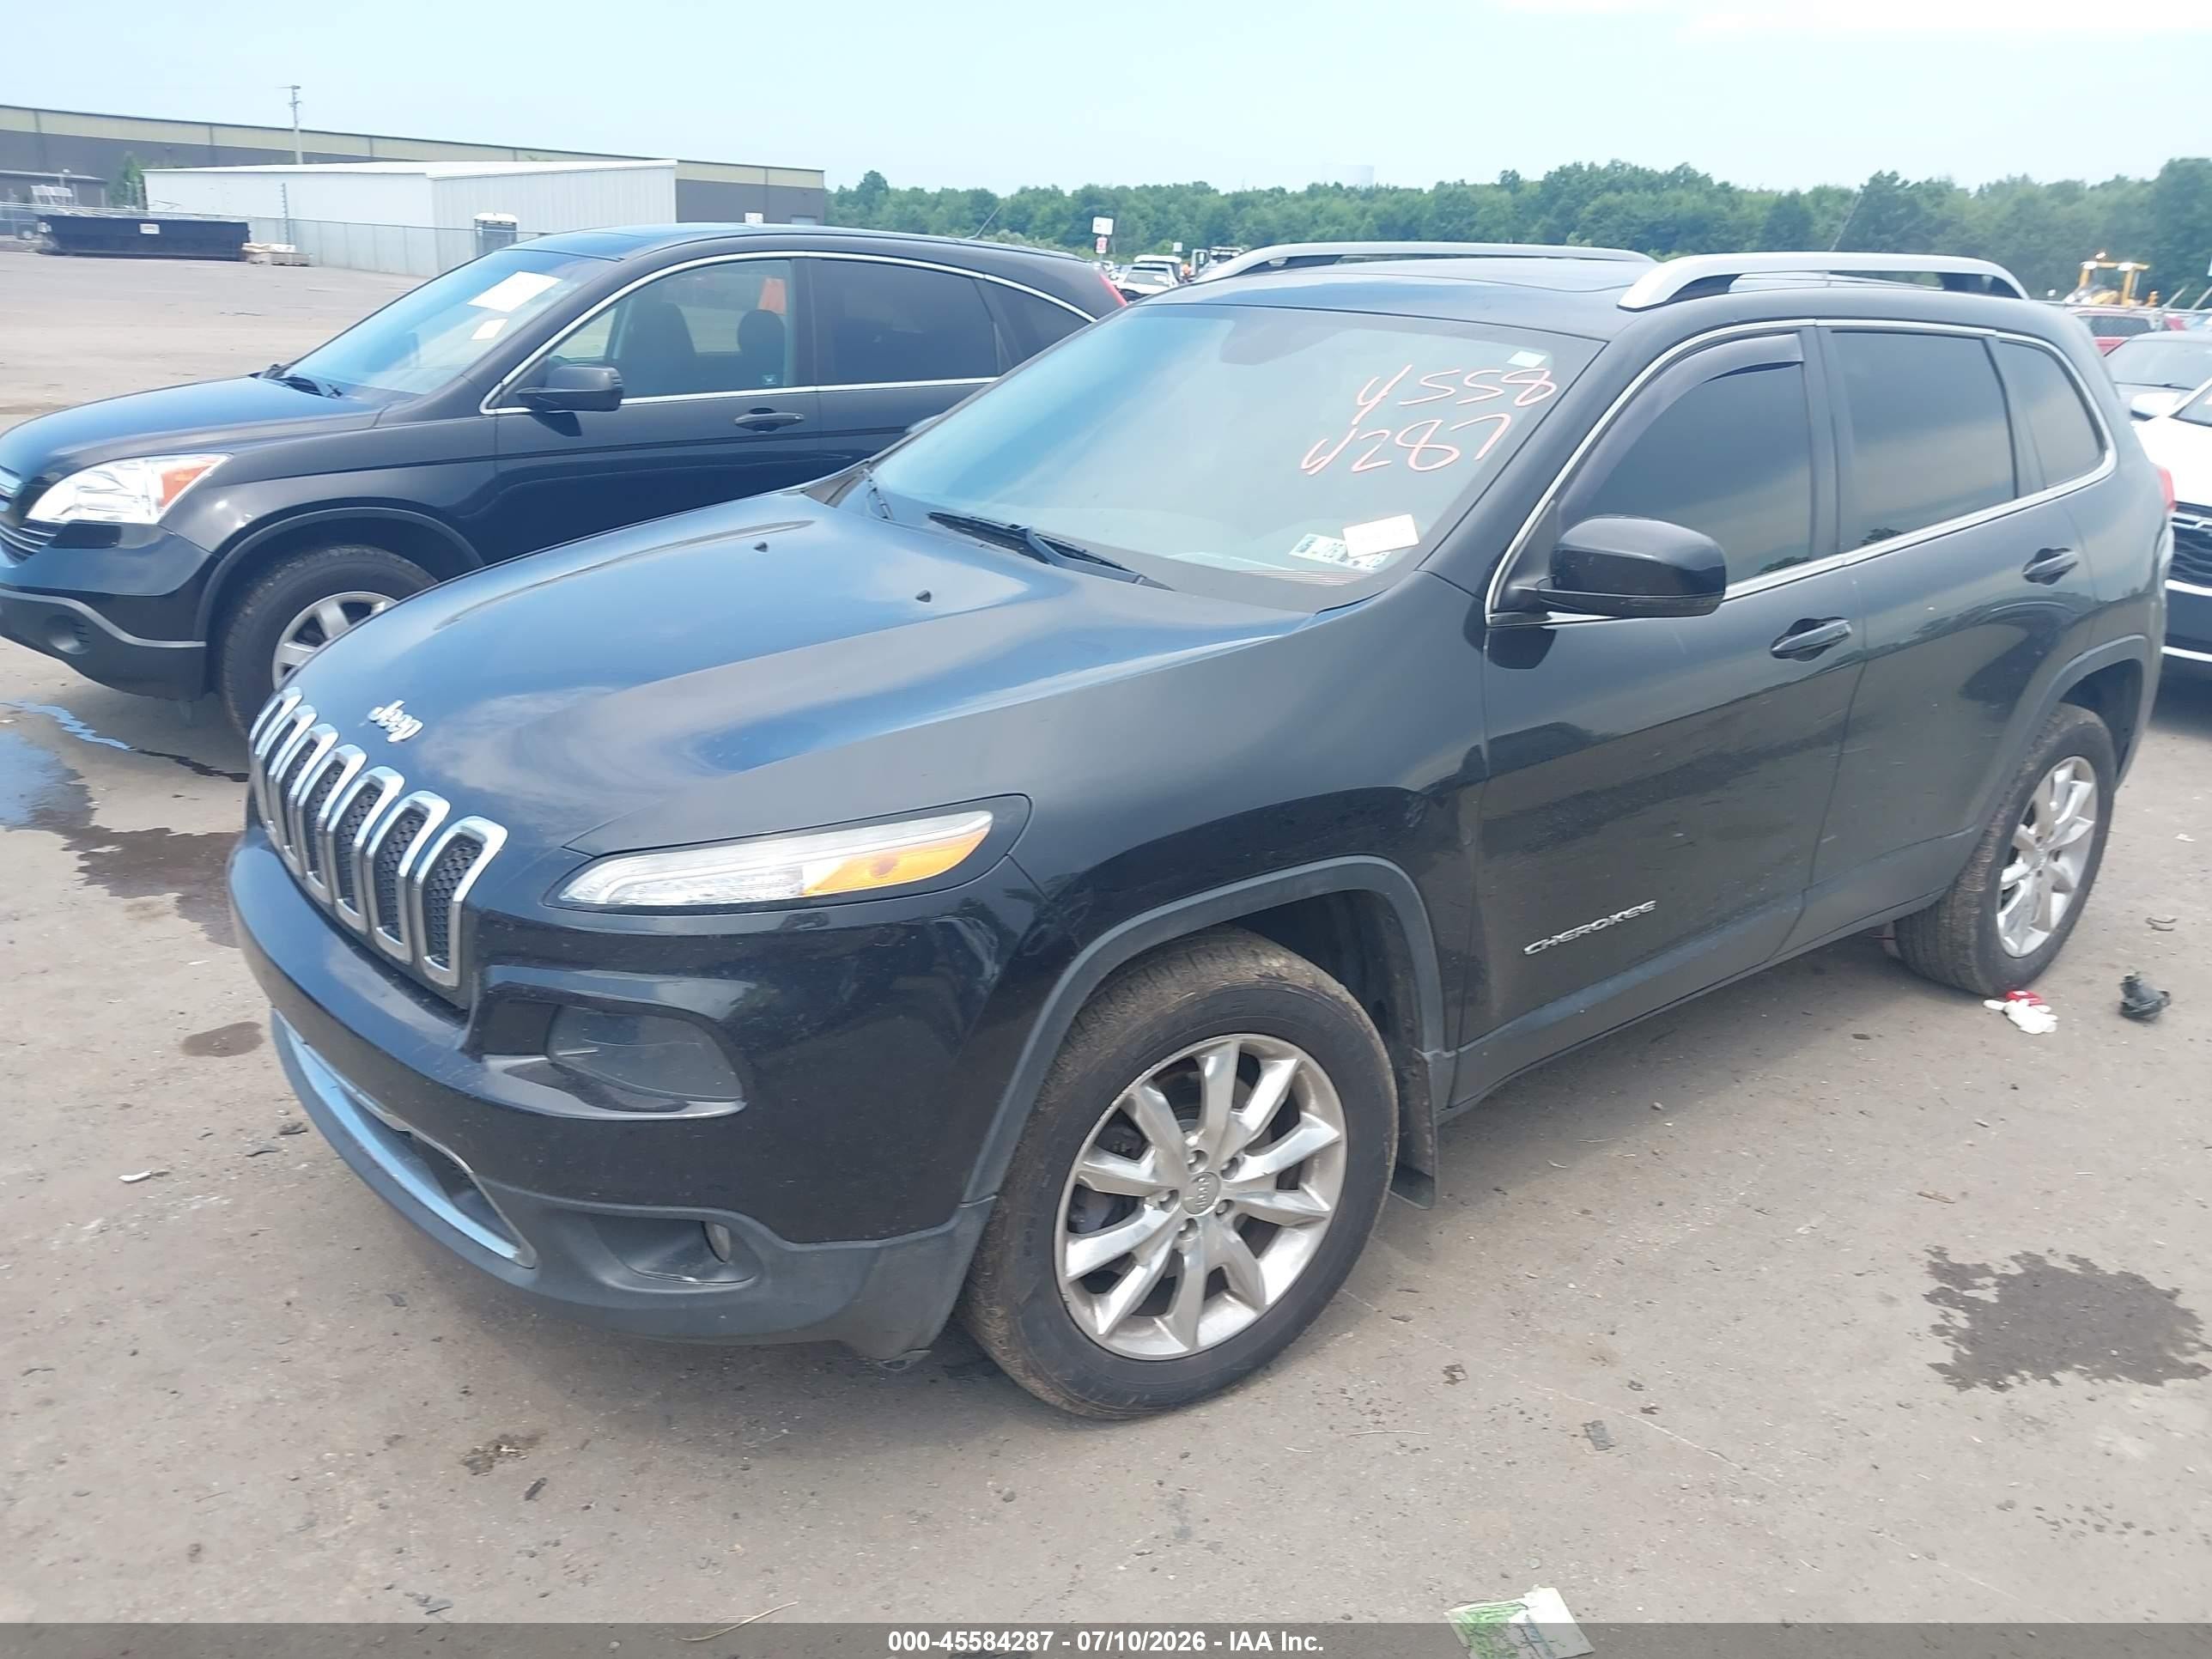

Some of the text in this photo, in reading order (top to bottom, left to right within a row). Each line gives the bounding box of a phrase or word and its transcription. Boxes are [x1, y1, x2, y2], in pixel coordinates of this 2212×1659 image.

[1351, 364, 1558, 426] 4558
[367, 699, 424, 743] Jeep
[1523, 899, 1656, 956] CHEROKEE
